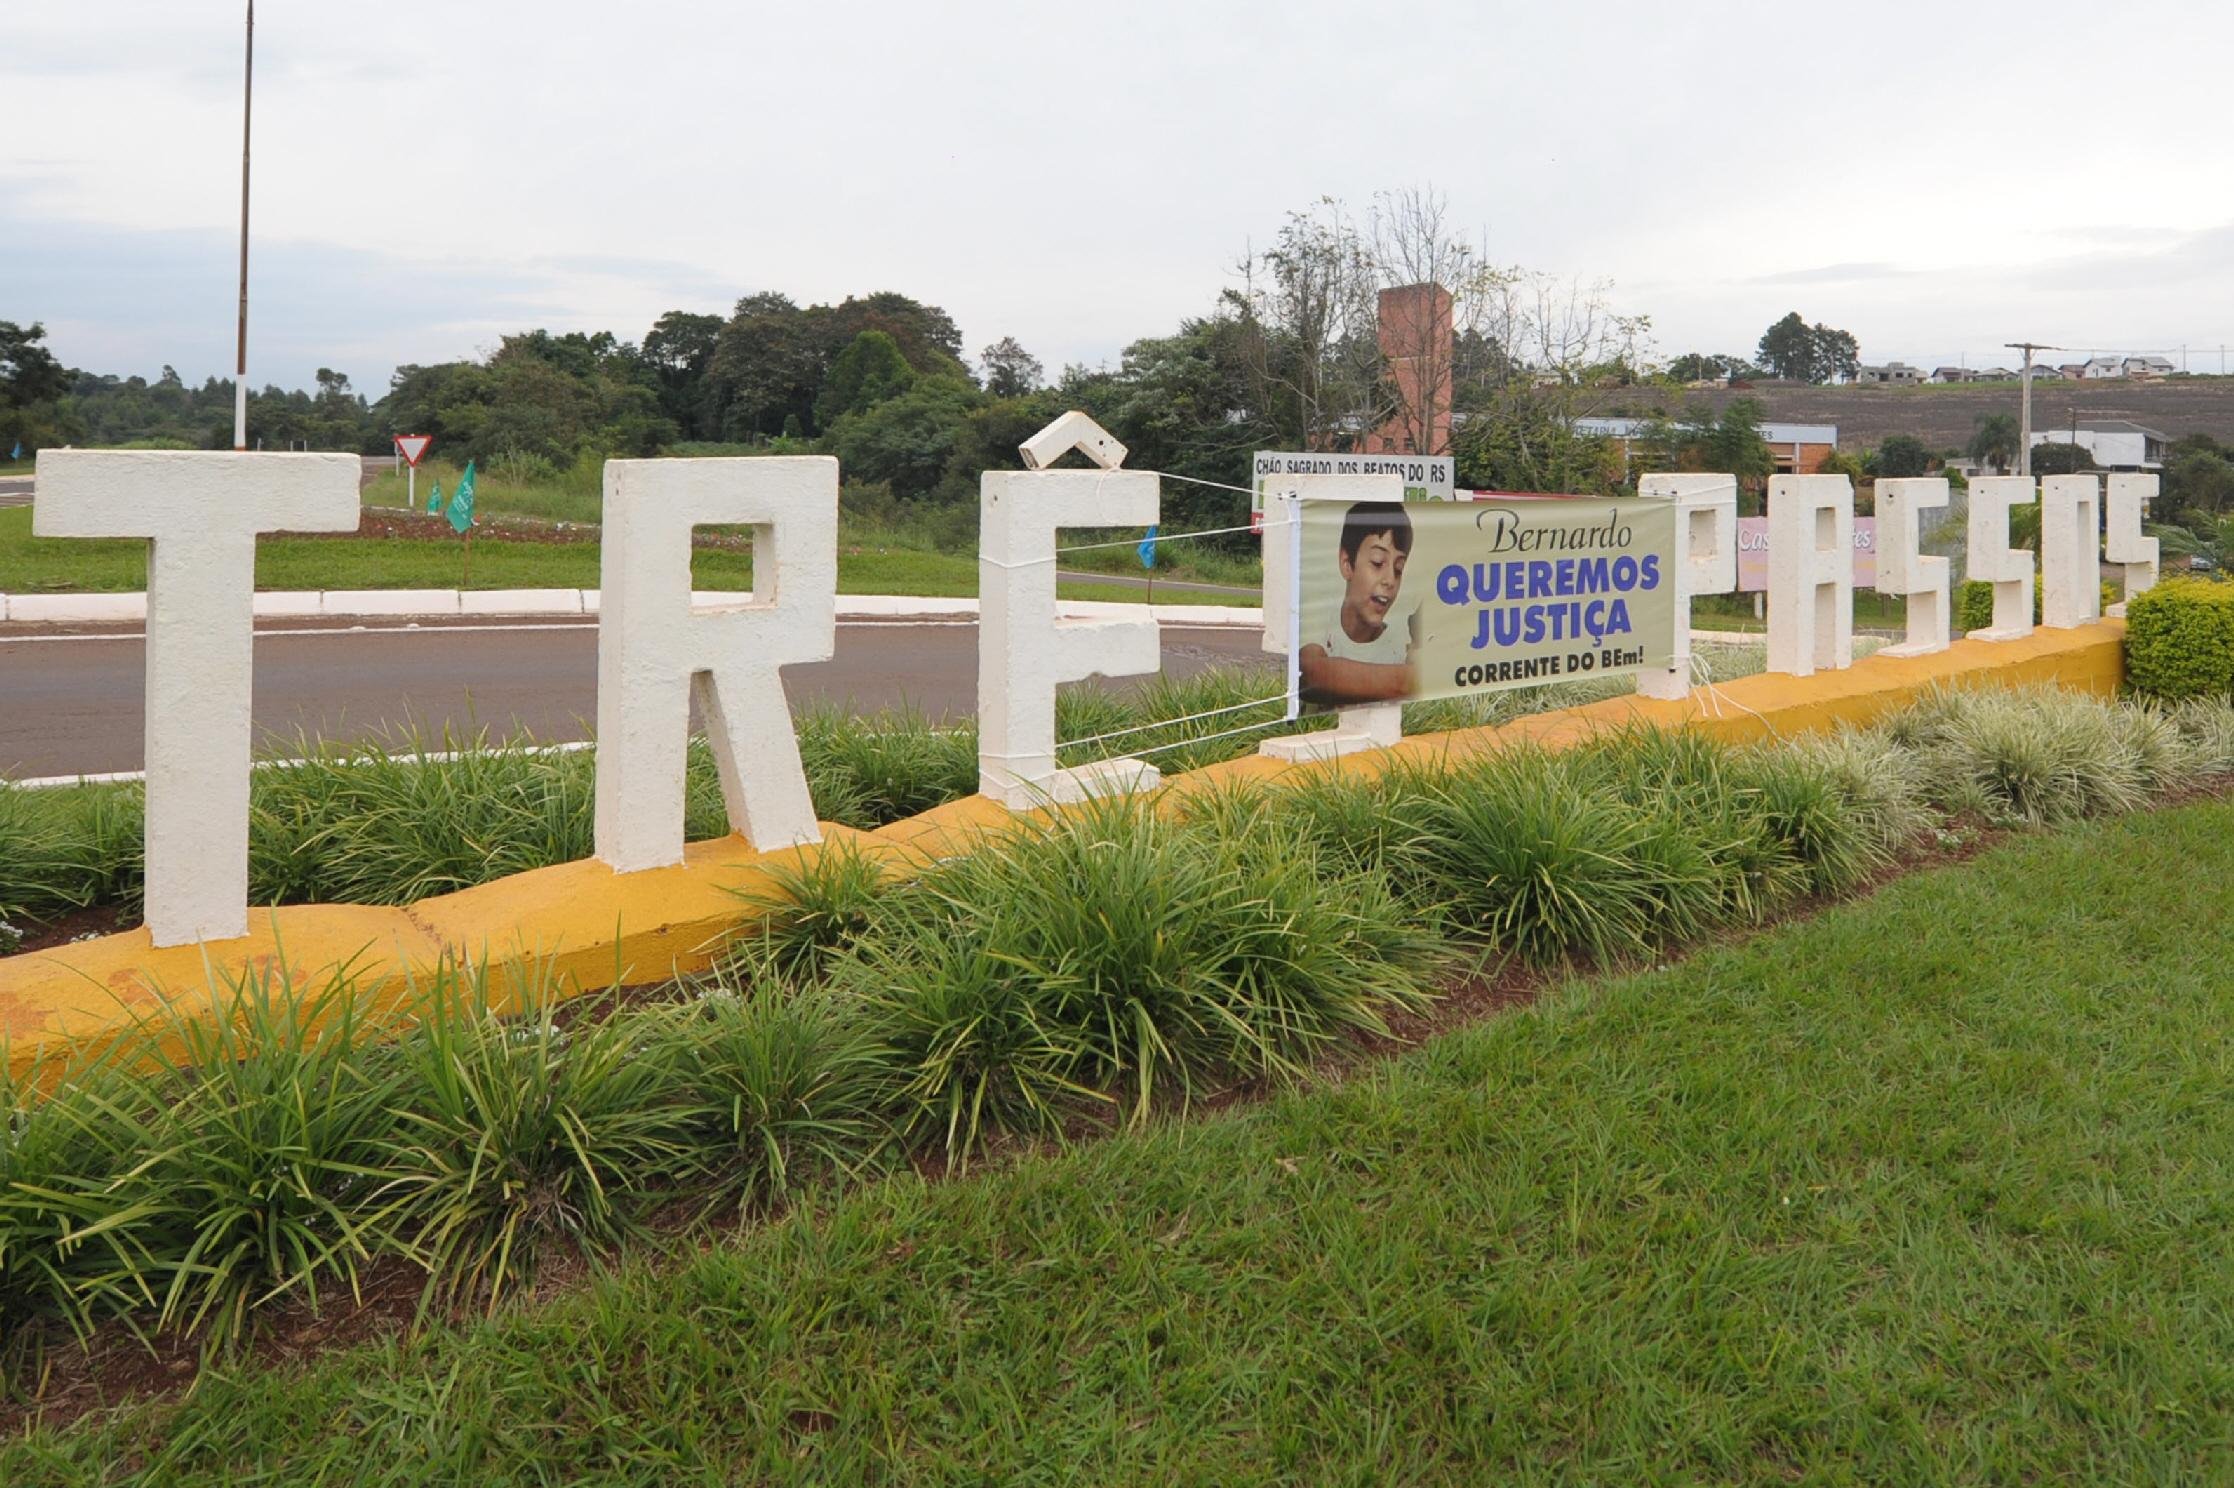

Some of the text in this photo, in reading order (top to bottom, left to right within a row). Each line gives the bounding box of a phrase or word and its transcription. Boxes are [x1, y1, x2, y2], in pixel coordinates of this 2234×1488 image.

[1286, 459, 1331, 475] SAGRADO
[1338, 461, 1358, 475] DOS
[1408, 463, 1424, 482] DO
[1430, 463, 1445, 483] RS
[1476, 508, 1632, 553] Bernardo
[1436, 554, 1660, 606] QUEREMOS
[1636, 472, 2160, 701] PASSOS
[1470, 599, 1632, 649] JUSTIÇA
[1455, 656, 1561, 687] CORRENTE
[1567, 652, 1595, 673] DO
